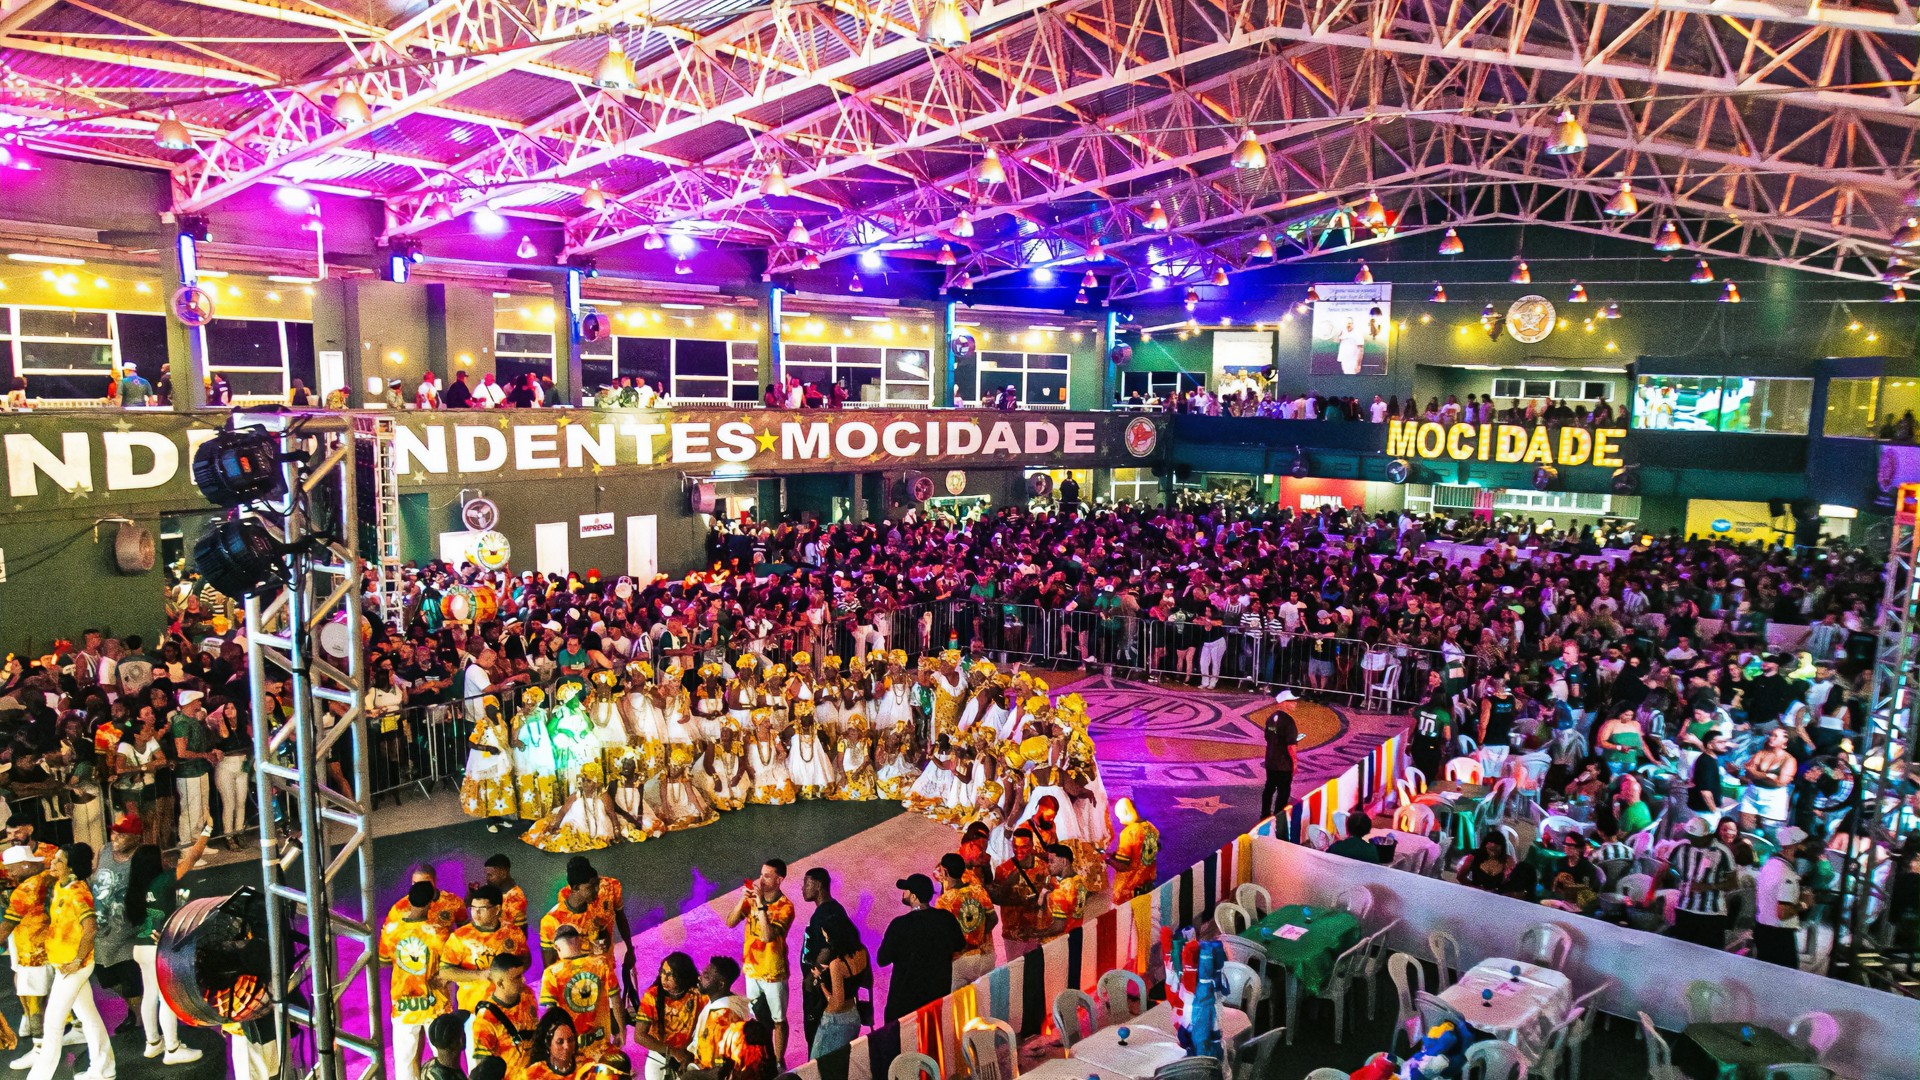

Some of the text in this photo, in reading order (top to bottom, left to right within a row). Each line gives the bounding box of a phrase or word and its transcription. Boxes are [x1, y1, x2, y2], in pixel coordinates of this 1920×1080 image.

[781, 421, 1096, 460] MOCIDADE
[1387, 420, 1627, 467] MOCIDADE
[581, 523, 613, 533] IMPRENSA
